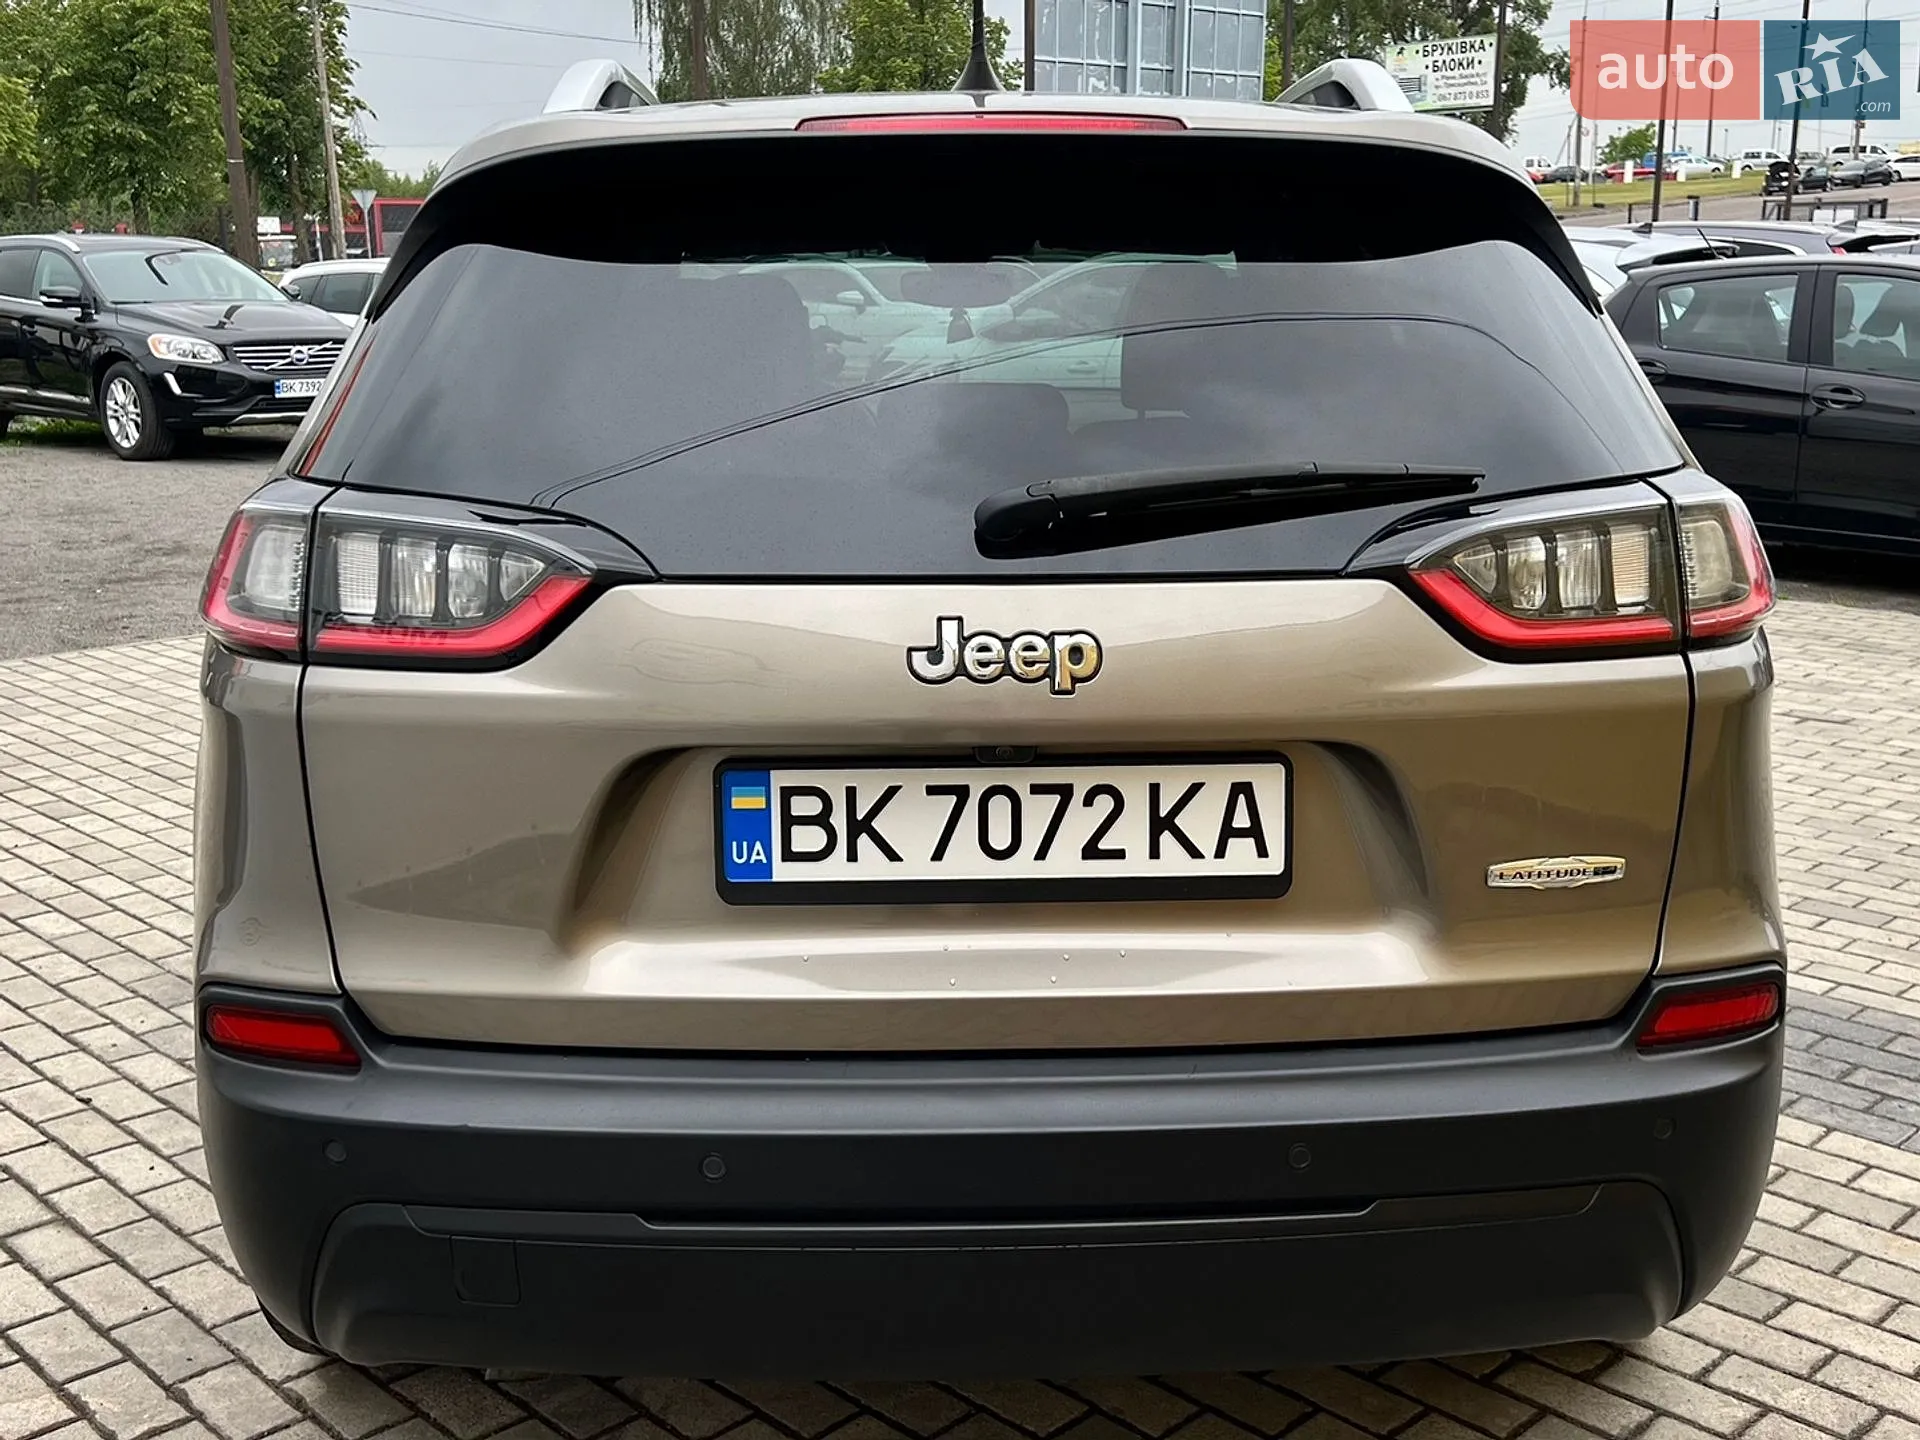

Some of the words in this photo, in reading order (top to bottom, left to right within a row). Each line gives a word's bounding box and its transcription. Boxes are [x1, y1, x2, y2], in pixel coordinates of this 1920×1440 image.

[1432, 57, 1475, 73] БЛОКИ
[281, 382, 297, 393] BK
[907, 616, 1103, 695] Jeep
[778, 784, 904, 863] BK
[924, 783, 1127, 861] 7072
[1148, 781, 1270, 860] KA
[732, 841, 767, 864] UA
[1498, 868, 1594, 880] LATITUDE
